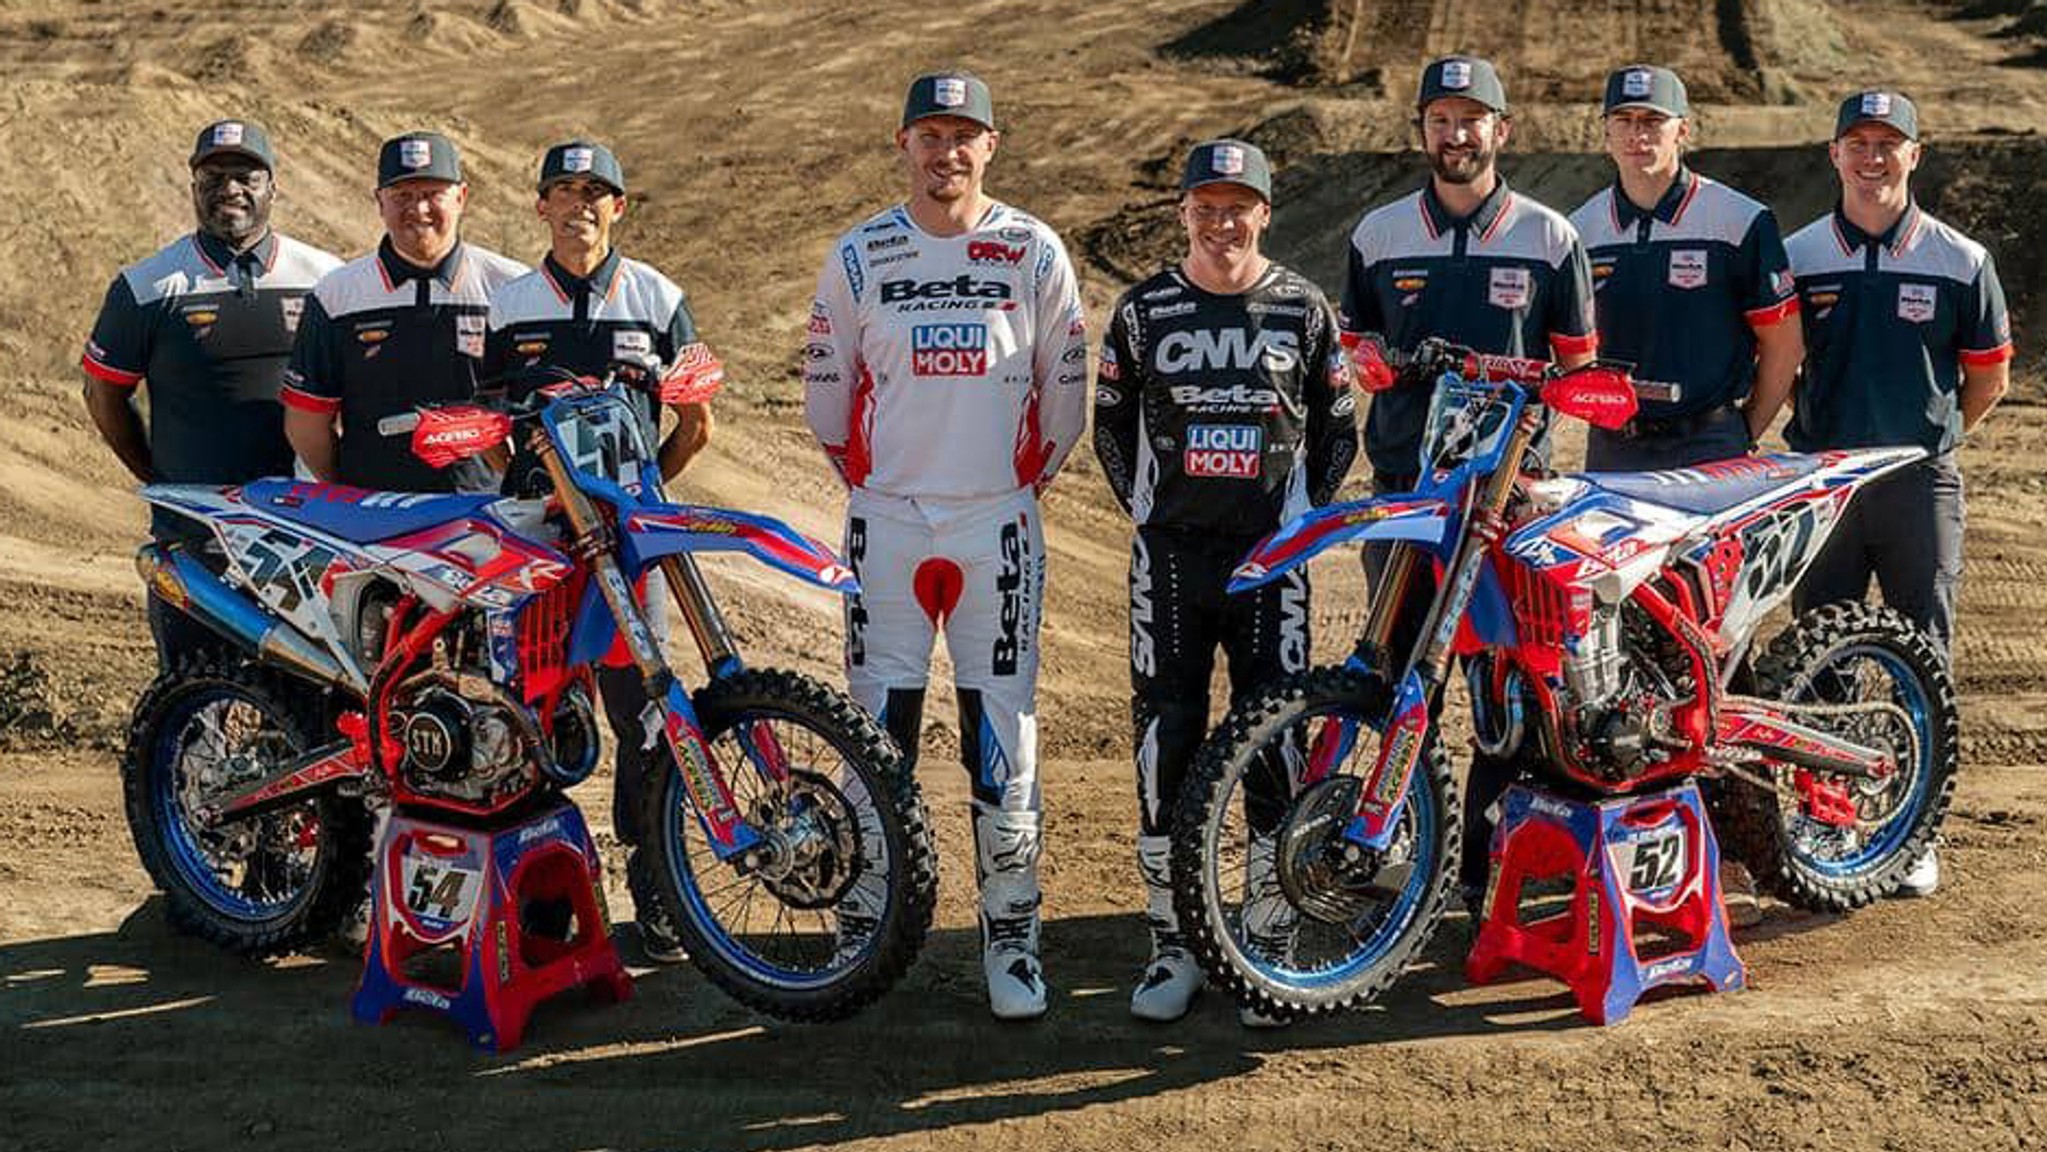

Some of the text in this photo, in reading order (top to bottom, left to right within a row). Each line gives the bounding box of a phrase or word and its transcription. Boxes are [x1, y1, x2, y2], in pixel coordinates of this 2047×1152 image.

[882, 275, 1012, 304] Beta
[898, 301, 978, 313] RACING
[916, 327, 983, 349] LIQUI
[917, 351, 983, 372] MOLY
[1156, 328, 1299, 374] CNVS
[1170, 384, 1279, 405] Beta
[1191, 428, 1258, 450] LIQUI
[1190, 452, 1258, 473] MOLY
[993, 522, 1021, 676] Beta
[1132, 533, 1156, 678] CNVS
[1629, 835, 1681, 889] 52
[409, 863, 468, 918] 54
